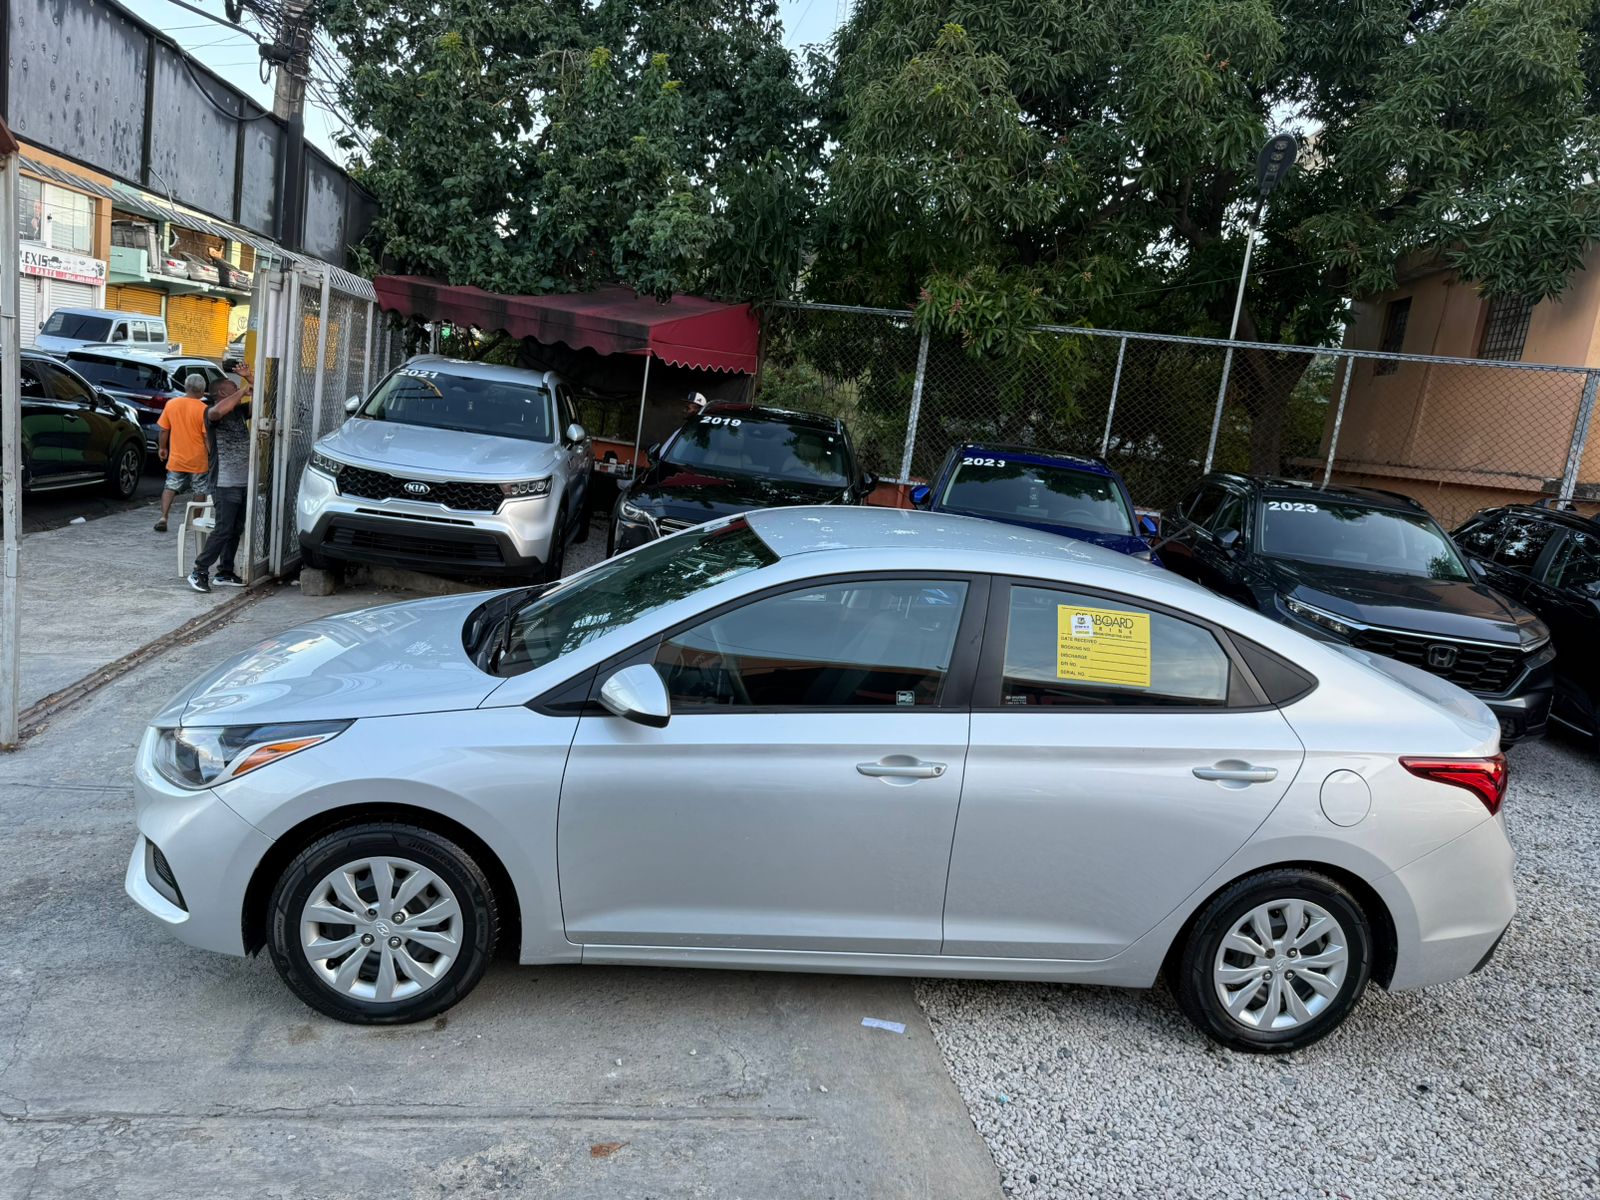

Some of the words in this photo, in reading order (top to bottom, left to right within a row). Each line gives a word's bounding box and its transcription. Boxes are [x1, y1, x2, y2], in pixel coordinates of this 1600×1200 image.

[397, 368, 438, 379] 2021
[700, 415, 742, 427] 2019
[962, 457, 1006, 468] 2023
[408, 484, 426, 493] KIA
[1268, 501, 1318, 513] 2023
[1075, 612, 1134, 629] ABOARD
